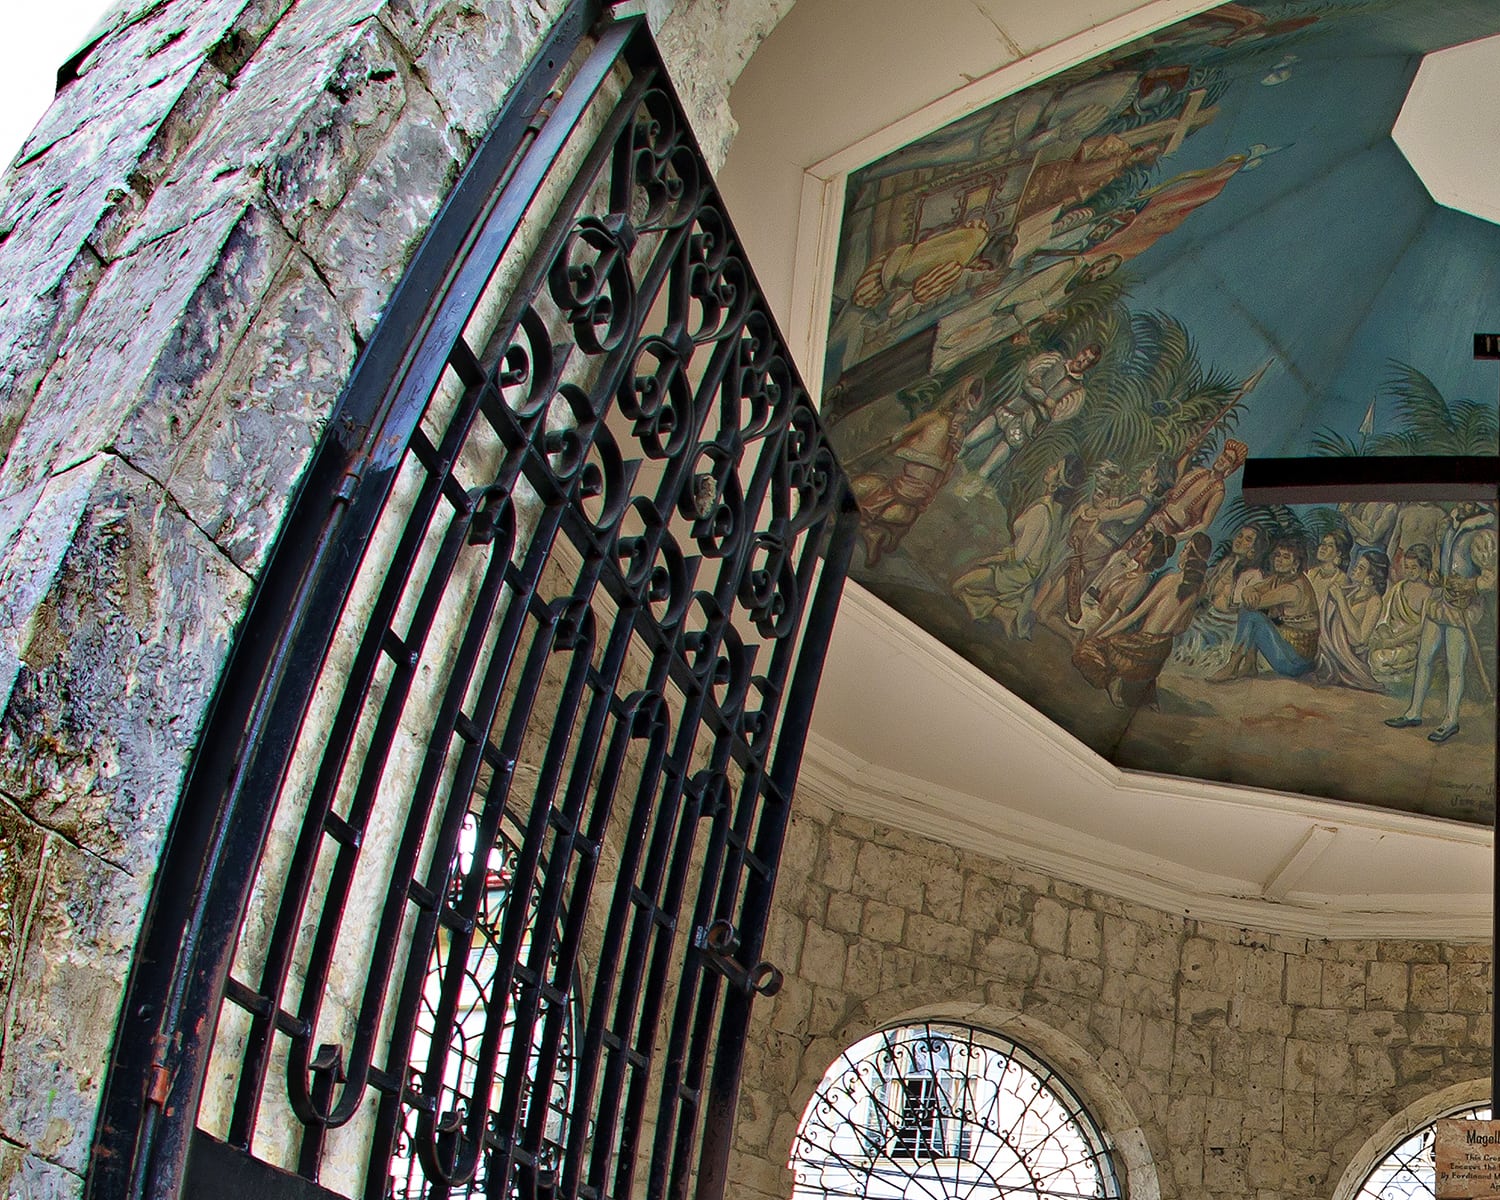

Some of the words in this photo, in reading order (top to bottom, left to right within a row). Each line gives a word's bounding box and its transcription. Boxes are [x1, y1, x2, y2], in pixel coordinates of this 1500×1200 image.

[1465, 1153, 1481, 1161] This
[1484, 1163, 1497, 1171] the
[1441, 1172, 1449, 1181] By
[1451, 1172, 1491, 1180] Ferdinand
